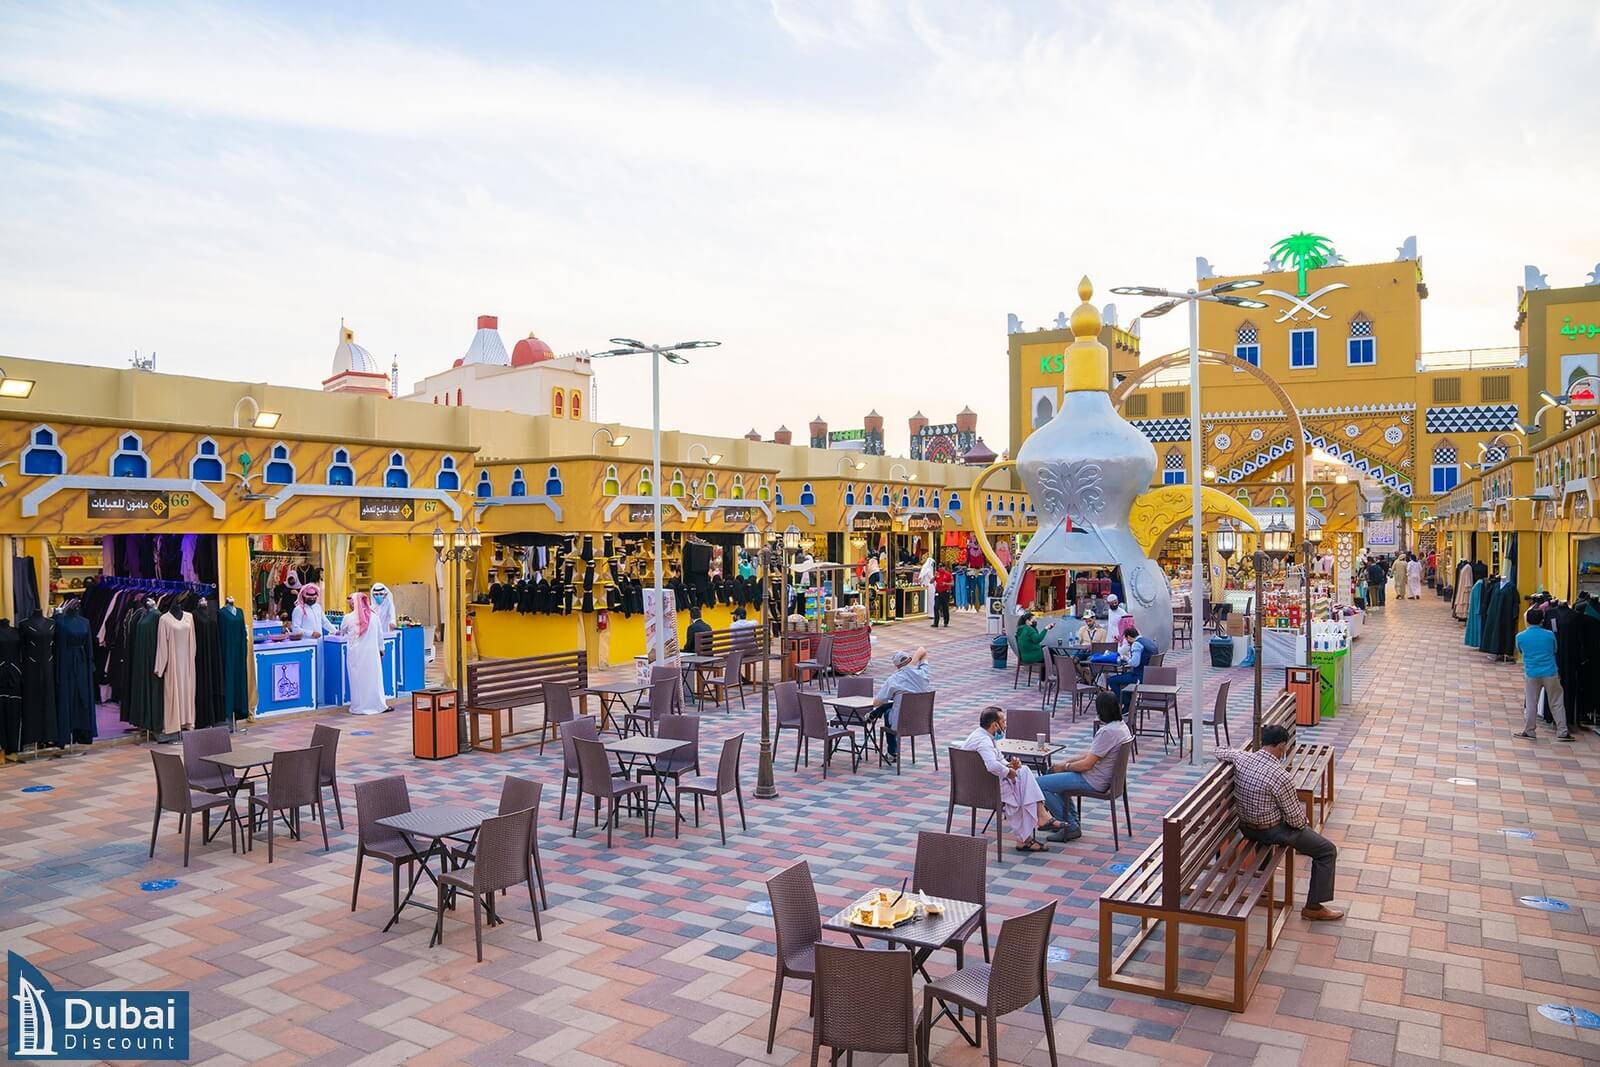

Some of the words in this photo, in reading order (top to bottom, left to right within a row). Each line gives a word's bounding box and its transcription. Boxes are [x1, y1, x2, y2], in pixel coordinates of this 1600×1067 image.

[1560, 316, 1600, 340] ودية
[1041, 353, 1064, 373] KS
[91, 498, 125, 511] للعبايات
[153, 502, 163, 511] 66
[171, 493, 190, 507] 66
[424, 501, 438, 512] 67
